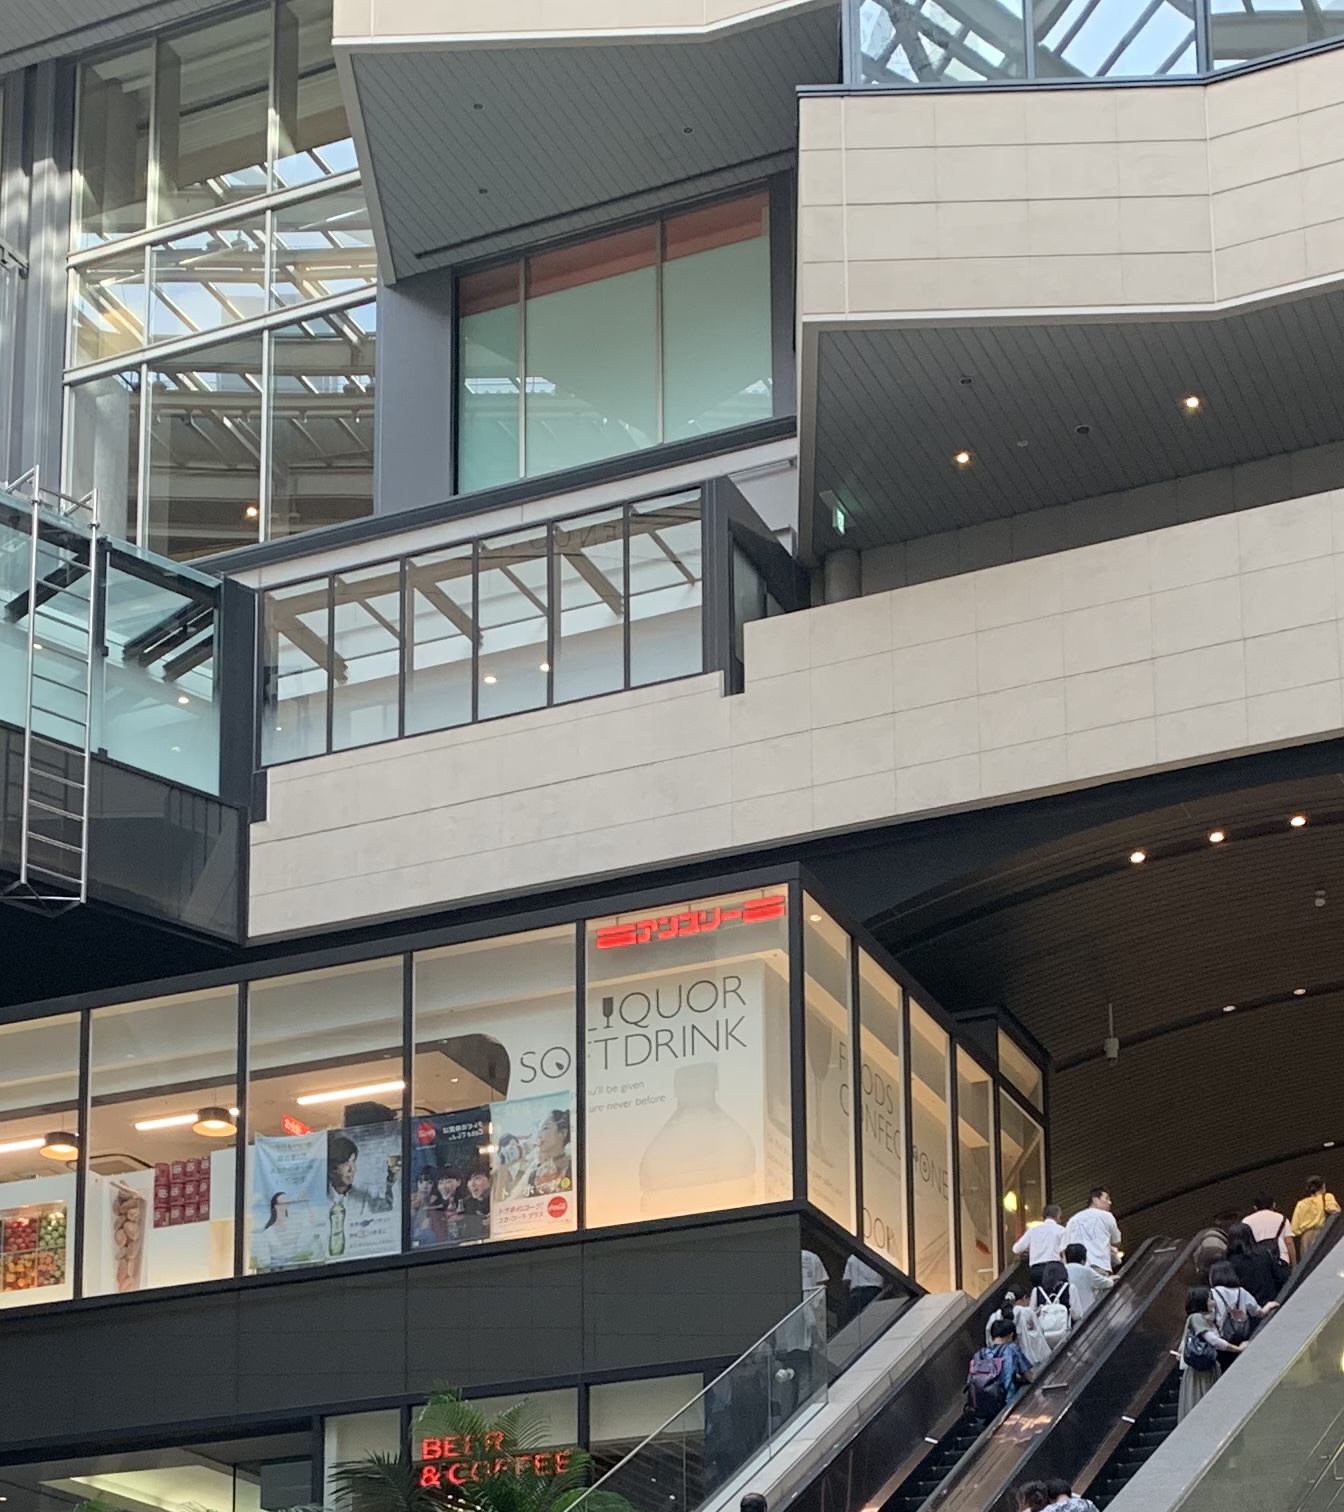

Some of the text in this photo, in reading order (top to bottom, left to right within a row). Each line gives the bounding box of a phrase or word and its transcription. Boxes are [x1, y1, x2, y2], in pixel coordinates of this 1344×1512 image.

[587, 975, 747, 1031] IQUOR
[620, 1079, 645, 1095] given
[607, 1099, 633, 1111] never
[635, 1094, 666, 1107] before
